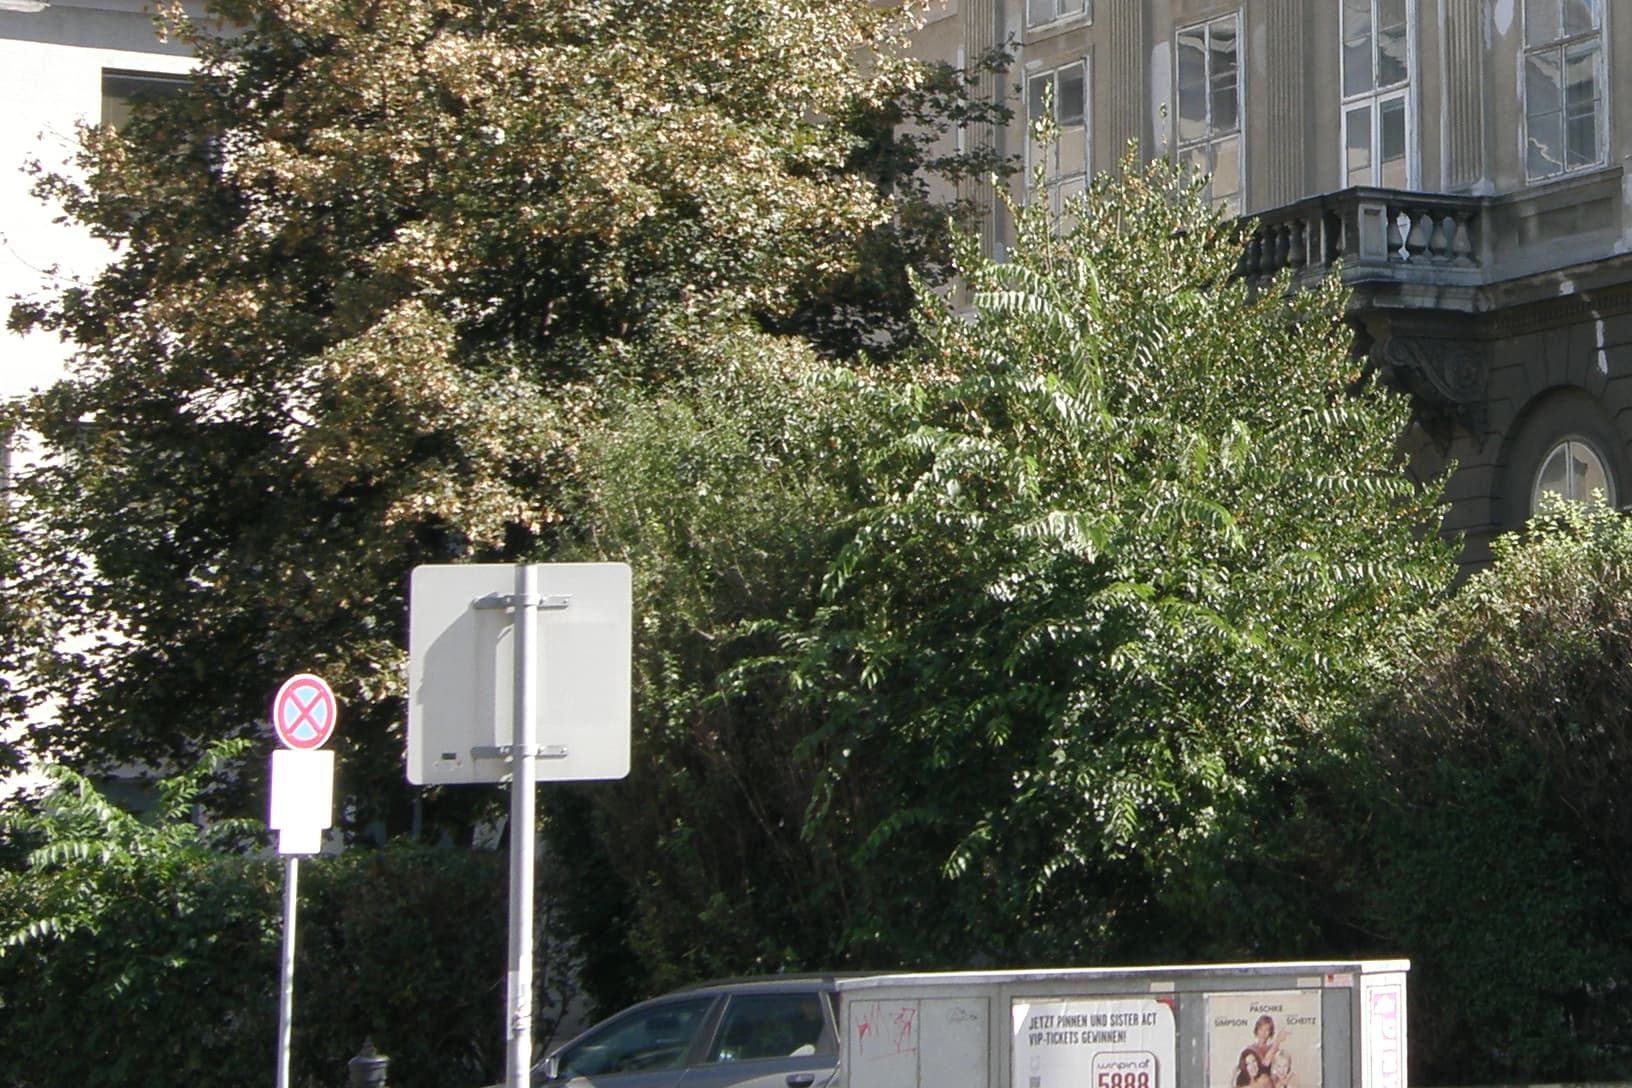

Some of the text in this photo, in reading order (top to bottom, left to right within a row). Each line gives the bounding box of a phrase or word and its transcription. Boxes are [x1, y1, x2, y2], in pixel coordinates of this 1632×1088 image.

[1029, 1015, 1054, 1030] JETZT
[1090, 1013, 1107, 1027] UND
[1110, 1013, 1139, 1026] SISTER
[1141, 1012, 1157, 1026] ACT
